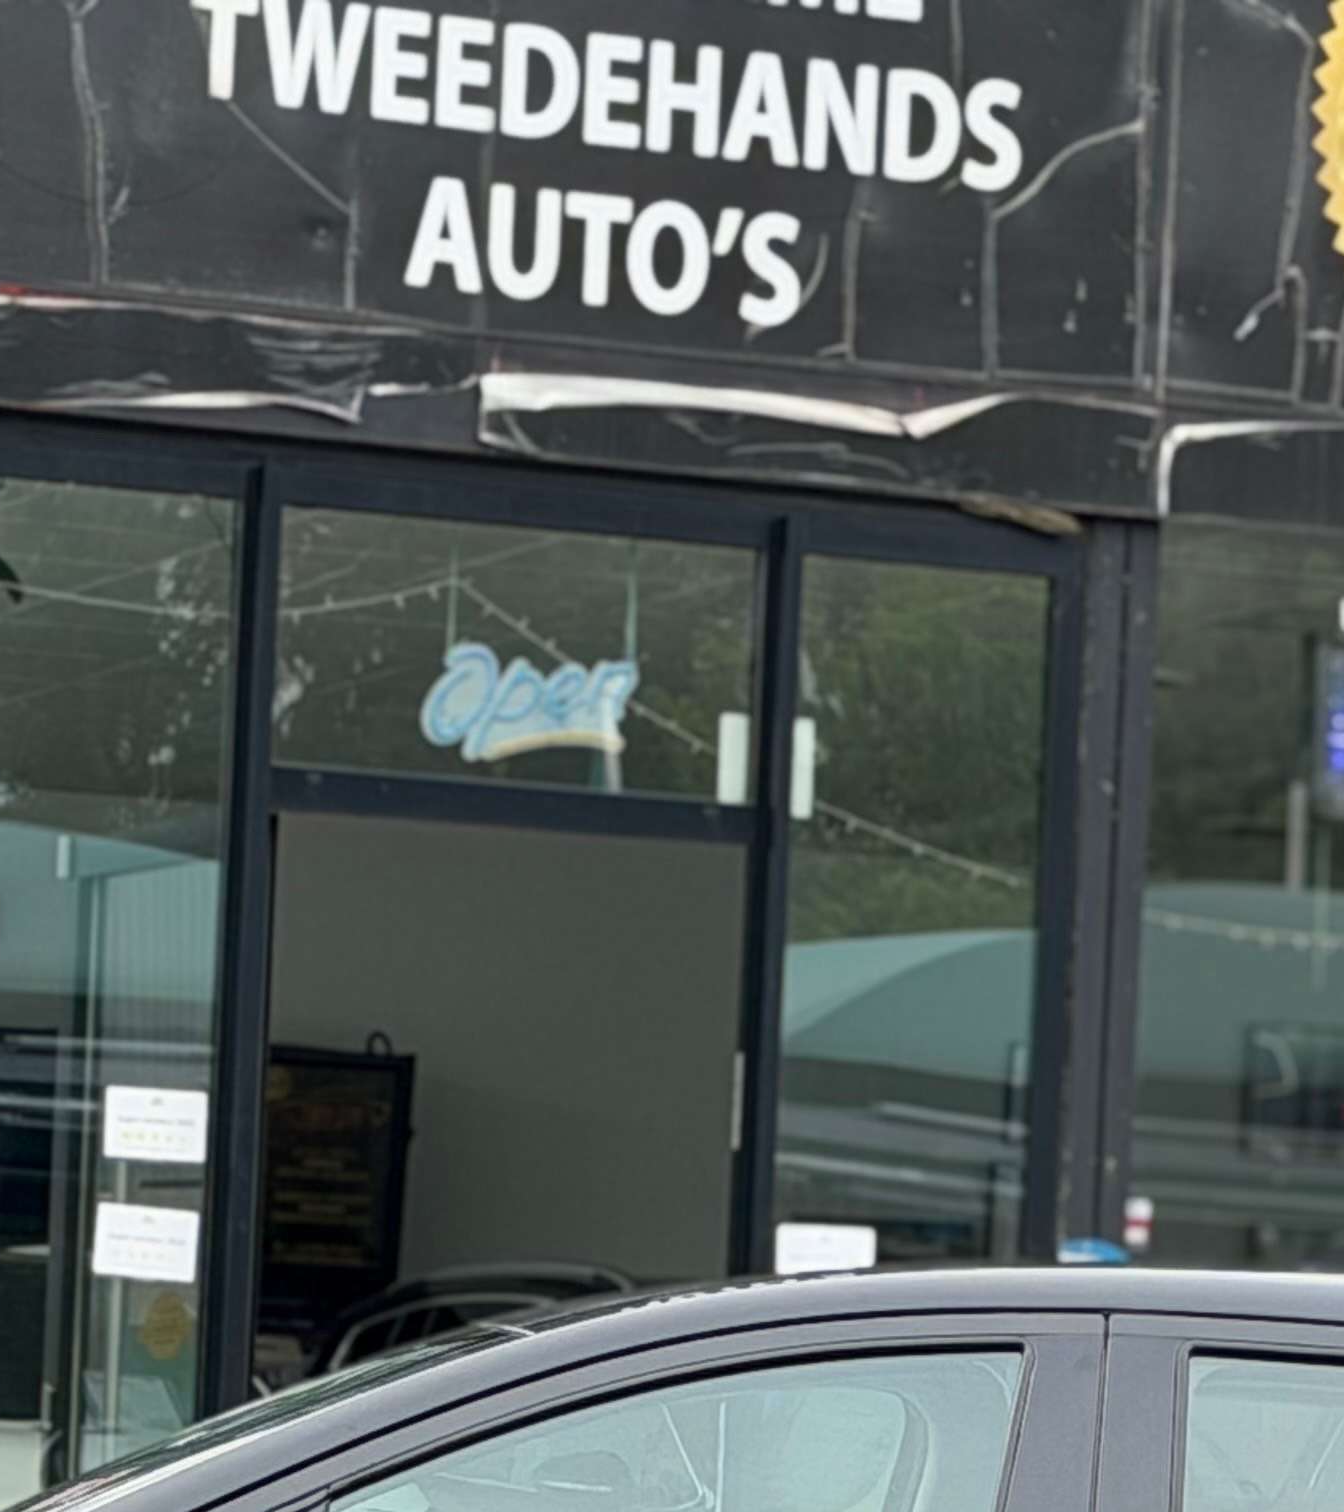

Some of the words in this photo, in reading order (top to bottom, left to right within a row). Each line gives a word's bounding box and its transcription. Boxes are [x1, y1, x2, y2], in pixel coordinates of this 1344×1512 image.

[190, 0, 1023, 192] TWEEDEHANDS
[404, 175, 801, 328] AUTO'S
[421, 641, 639, 763] Open
